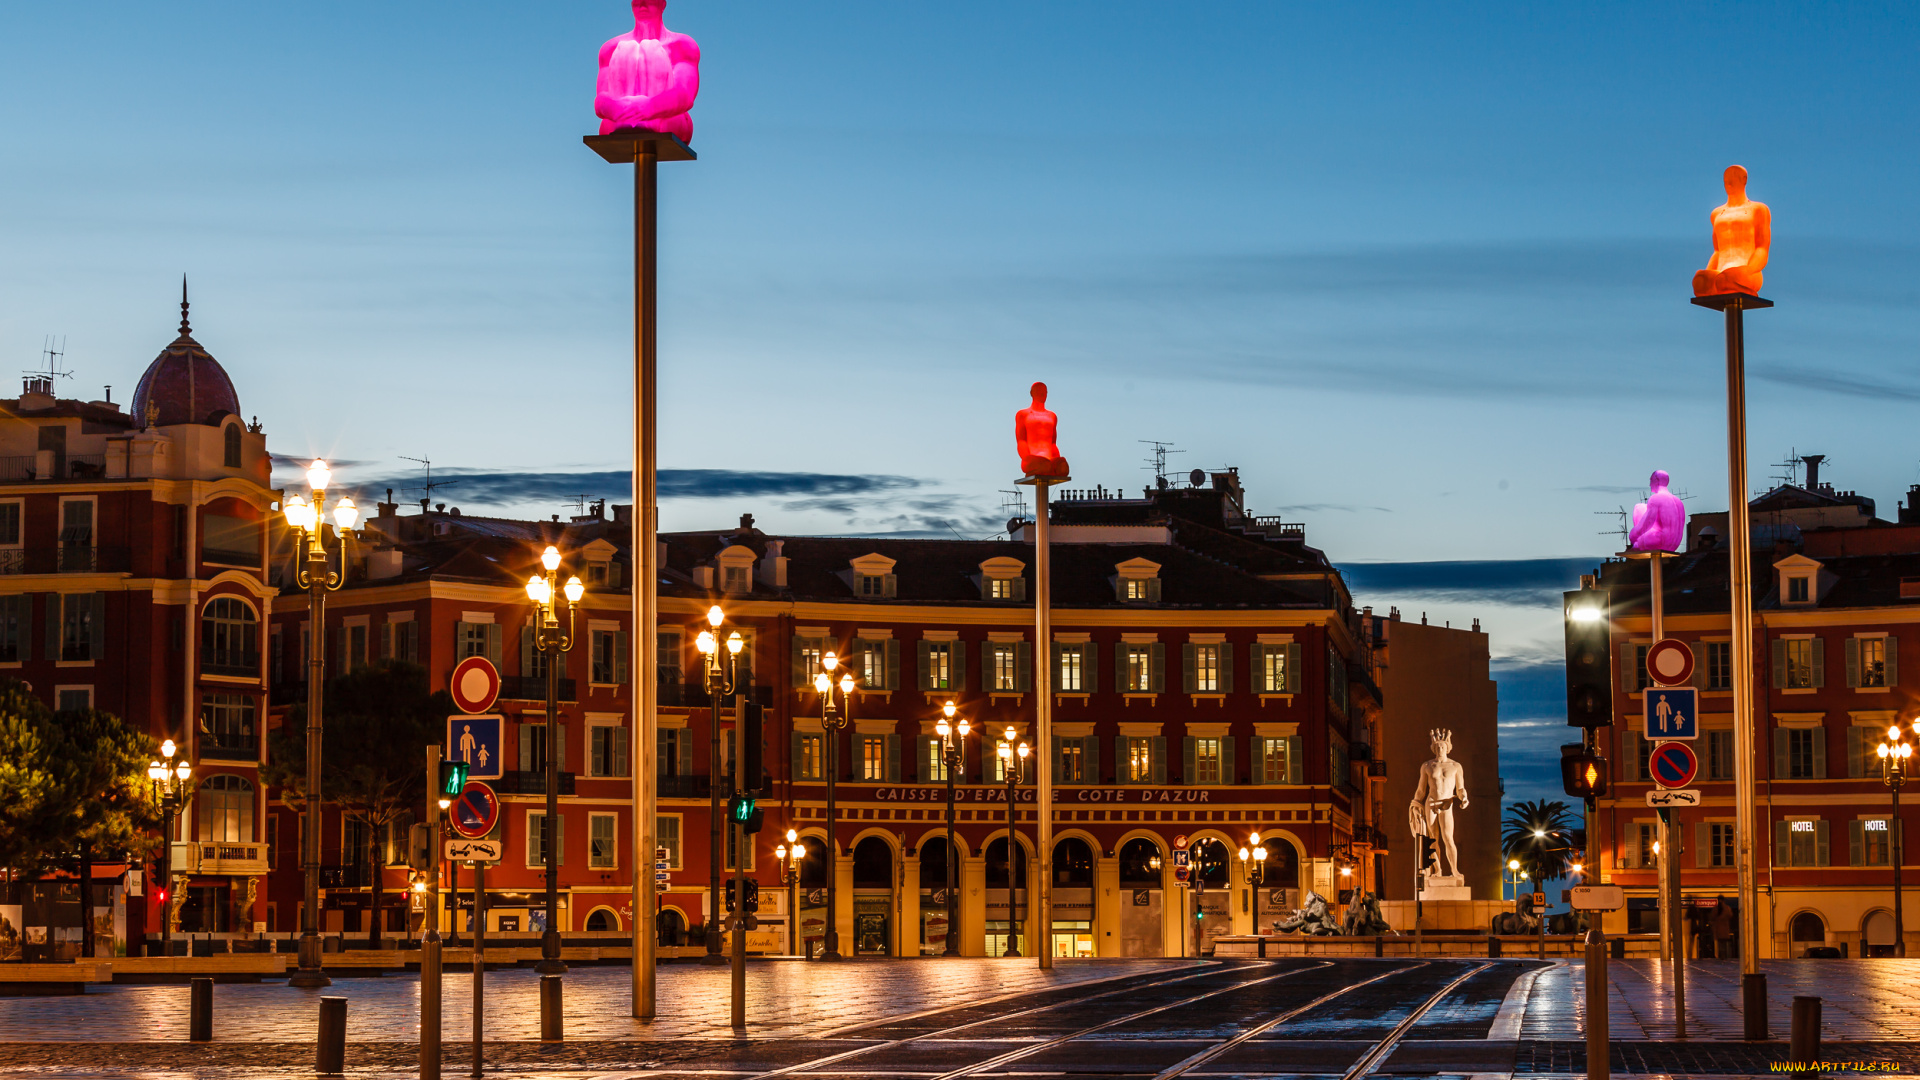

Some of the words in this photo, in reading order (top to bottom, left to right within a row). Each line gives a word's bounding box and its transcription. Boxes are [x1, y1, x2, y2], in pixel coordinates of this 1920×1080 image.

[875, 788, 939, 801] CAISSE
[954, 789, 1060, 801] D'EPARGE
[1077, 789, 1125, 802] COTE
[1141, 790, 1209, 802] D'AZUR
[1791, 821, 1814, 832] HOTEL
[1864, 820, 1887, 831] HOTEL
